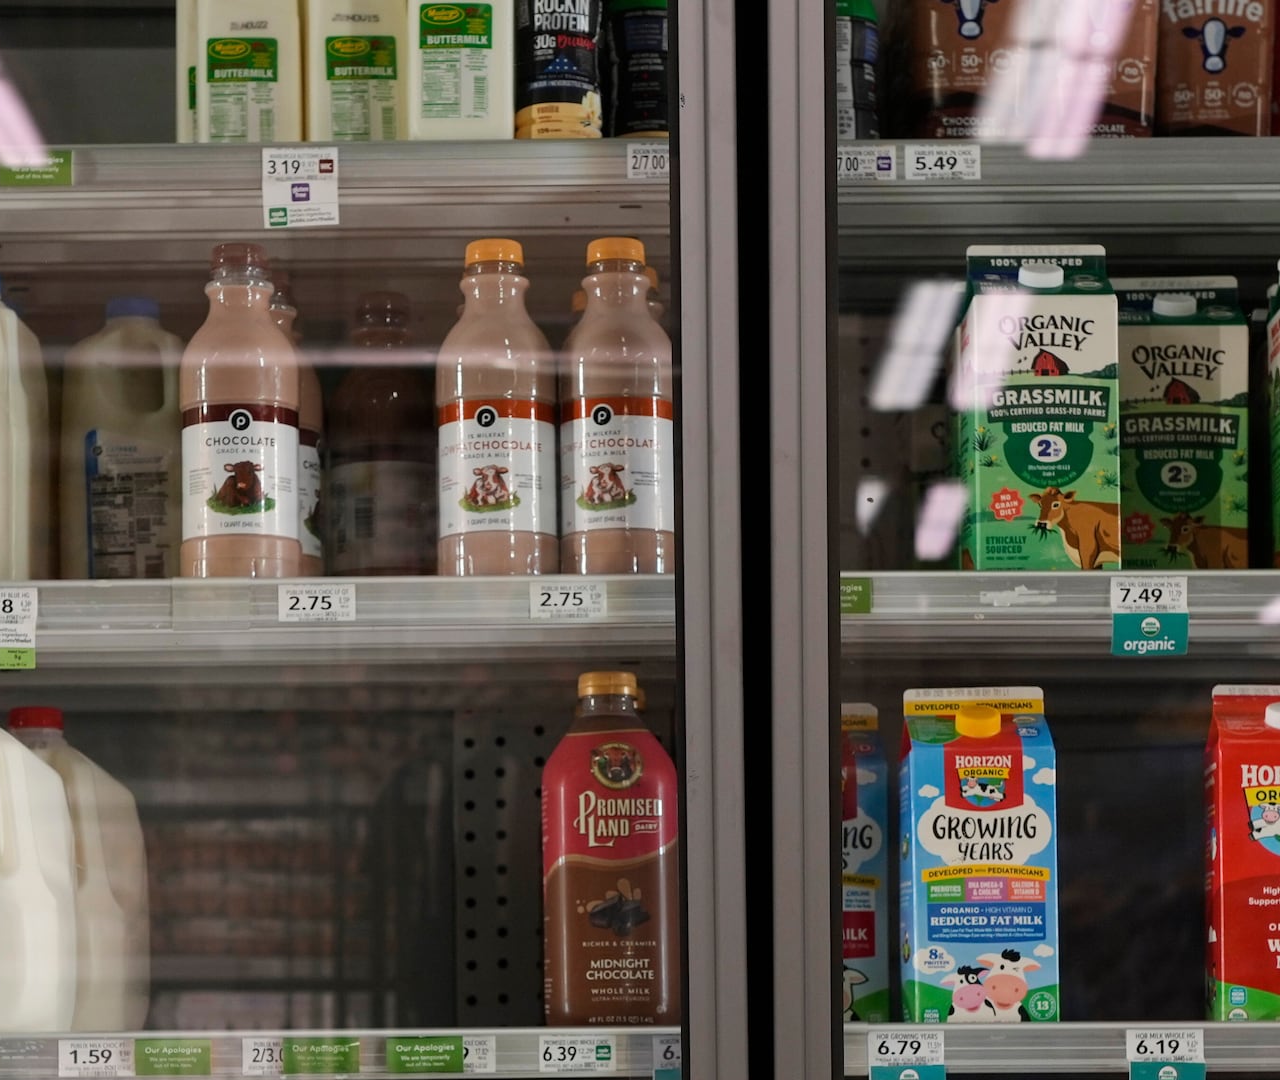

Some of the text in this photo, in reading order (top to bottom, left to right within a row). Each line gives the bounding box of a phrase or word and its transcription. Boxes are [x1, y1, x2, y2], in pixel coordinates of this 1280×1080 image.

[534, 14, 589, 32] PROTEIN
[427, 35, 488, 46] BUTTERMILK
[214, 68, 274, 78] BUTTERMILK
[334, 66, 394, 76] BUTTERMILK
[267, 160, 300, 174] 3.19
[632, 155, 665, 169] 2/7.00
[915, 156, 958, 170] 5.49
[1007, 332, 1087, 351] VALLEY
[990, 407, 1106, 418] 100% CERTIFIED GRASS-FED FARMS
[1011, 422, 1085, 433] REDUCED FAT MILK
[205, 437, 276, 448] CHOCOLATE
[986, 535, 1027, 545] ETHICALLY
[985, 544, 1023, 553] SOURCED
[540, 592, 584, 607] 2.75
[1120, 587, 1163, 604] 7.49
[289, 595, 332, 611] 2.75
[955, 755, 1011, 768] HORIZON
[634, 823, 658, 831] DAIRY
[932, 814, 1037, 840] GROWING
[928, 866, 1054, 878] DEVELOPED PEDIATRICIANS
[930, 915, 1043, 927] REDUCED FAT MILK
[591, 959, 650, 969] MIDNIGHT
[586, 969, 655, 980] CHOCOLATE
[396, 1043, 456, 1055] Our Apologies
[877, 1040, 921, 1056] 6.79
[1136, 1040, 1179, 1055] 6.19
[68, 1049, 113, 1064] 1.59
[542, 1046, 577, 1062] 6.39
